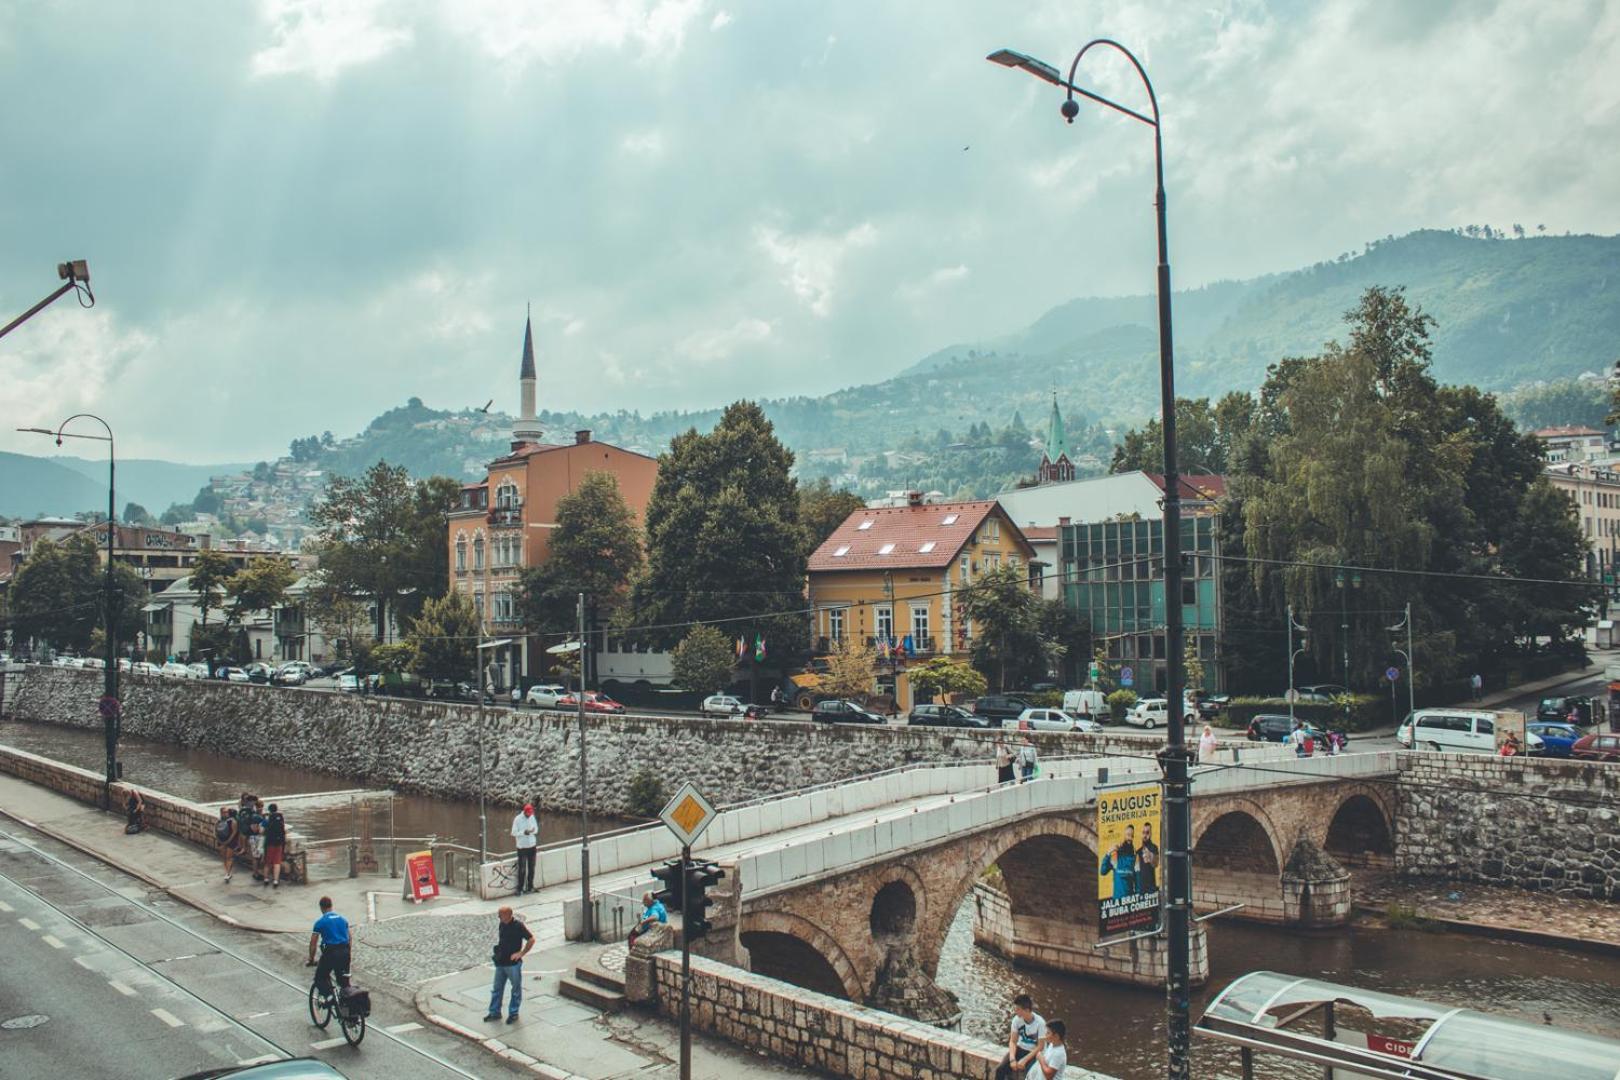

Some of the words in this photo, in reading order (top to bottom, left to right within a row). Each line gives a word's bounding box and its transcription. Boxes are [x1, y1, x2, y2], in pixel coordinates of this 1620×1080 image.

[1101, 810, 1147, 824] SKENDERIJA
[1101, 897, 1120, 910] JALA
[1121, 894, 1140, 905] BRAT
[1101, 911, 1107, 919] &
[1108, 906, 1129, 917] BUBA
[1130, 898, 1159, 912] CORELLI
